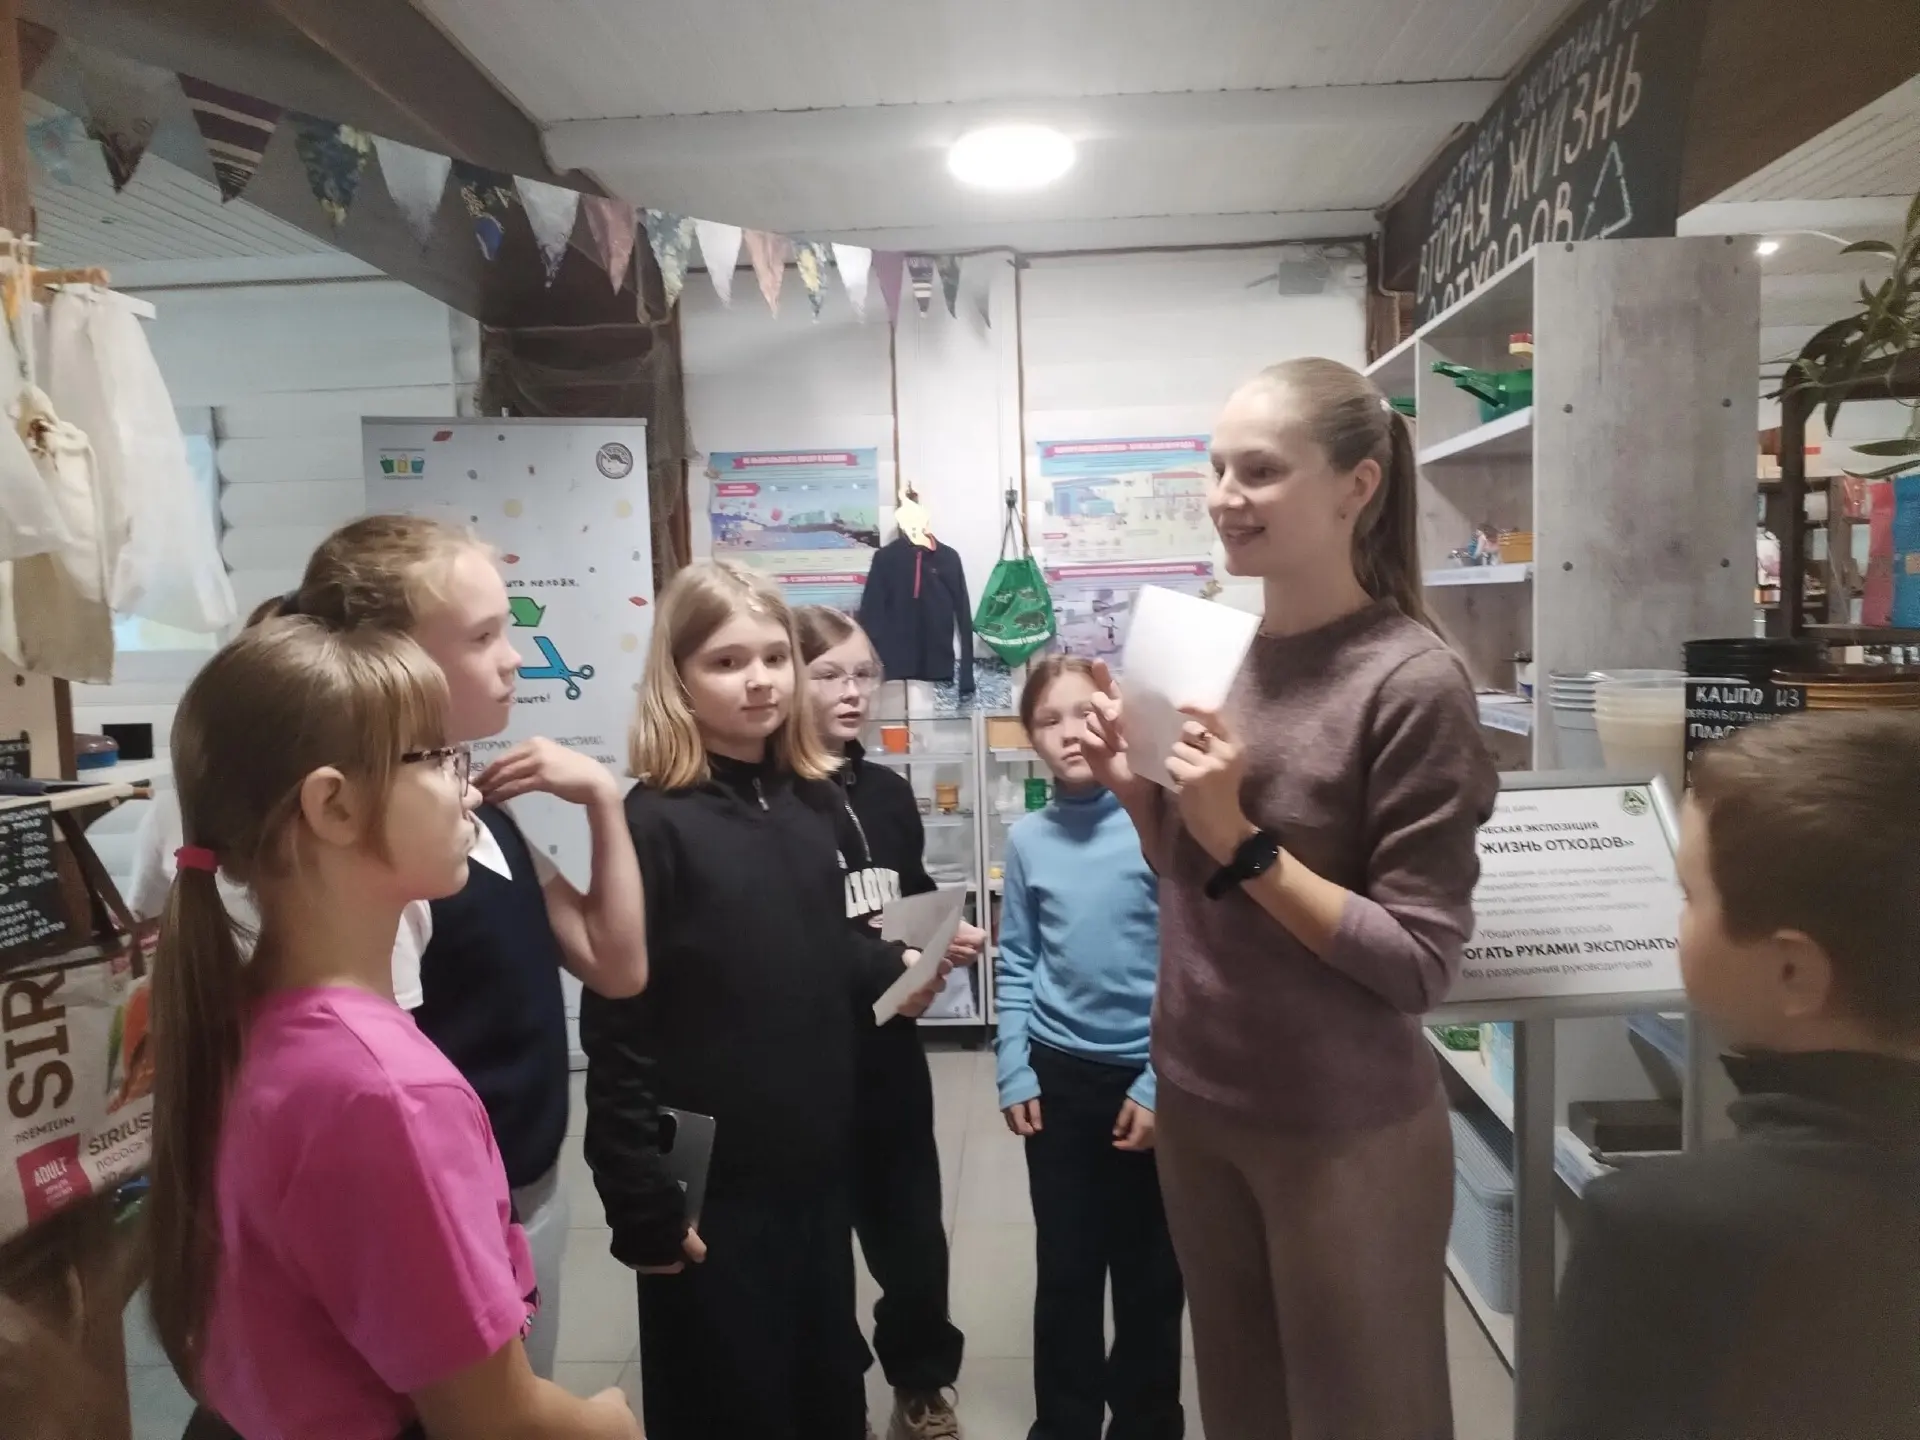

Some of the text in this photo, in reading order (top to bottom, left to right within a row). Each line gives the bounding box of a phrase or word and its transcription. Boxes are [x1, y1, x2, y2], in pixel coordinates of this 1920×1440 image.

[1503, 31, 1642, 220] ЖИЗНЬ
[1696, 686, 1800, 708] КАШПО ИЗ
[1689, 723, 1746, 739] ПЛАС
[1480, 840, 1542, 854] ЖИЗНЬ
[1463, 946, 1514, 960] ОГАТЬ
[1516, 942, 1581, 957] РУКАМИ
[2, 968, 74, 1119] SIR
[15, 1116, 76, 1144] PREMIUM
[34, 1157, 68, 1187] ADULT
